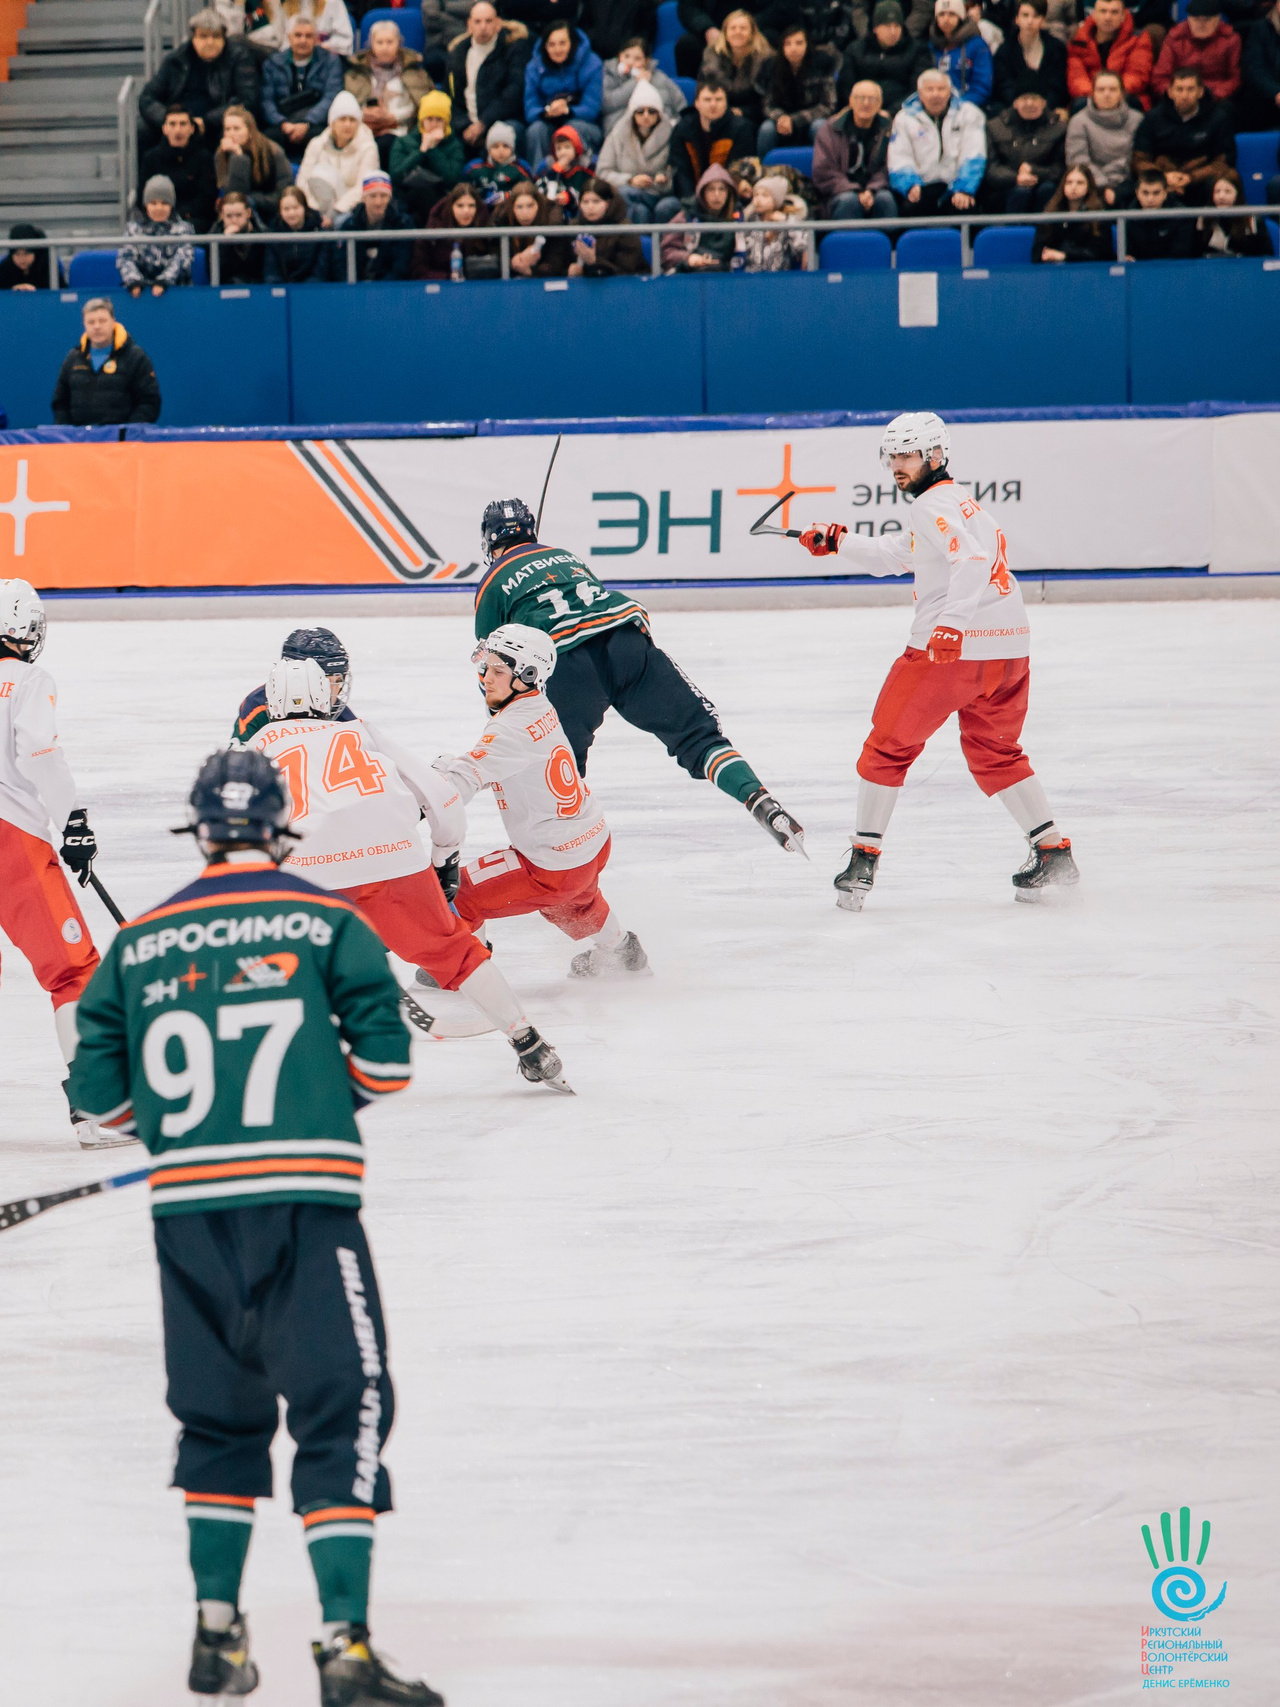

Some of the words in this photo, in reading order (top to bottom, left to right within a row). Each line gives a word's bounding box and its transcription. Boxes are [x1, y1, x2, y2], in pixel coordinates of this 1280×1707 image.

[852, 479, 1022, 507] эния
[964, 627, 1015, 638] РДЛОВСКАЯ
[533, 654, 548, 664] CCM
[271, 729, 387, 825] 14
[65, 835, 95, 847] CC
[283, 848, 364, 867] ВЕРДЛОВСКАЯ
[367, 839, 413, 857] ОБЛАСТЬ
[122, 911, 334, 967] АБРОСИМОВ
[141, 998, 305, 1138] 97
